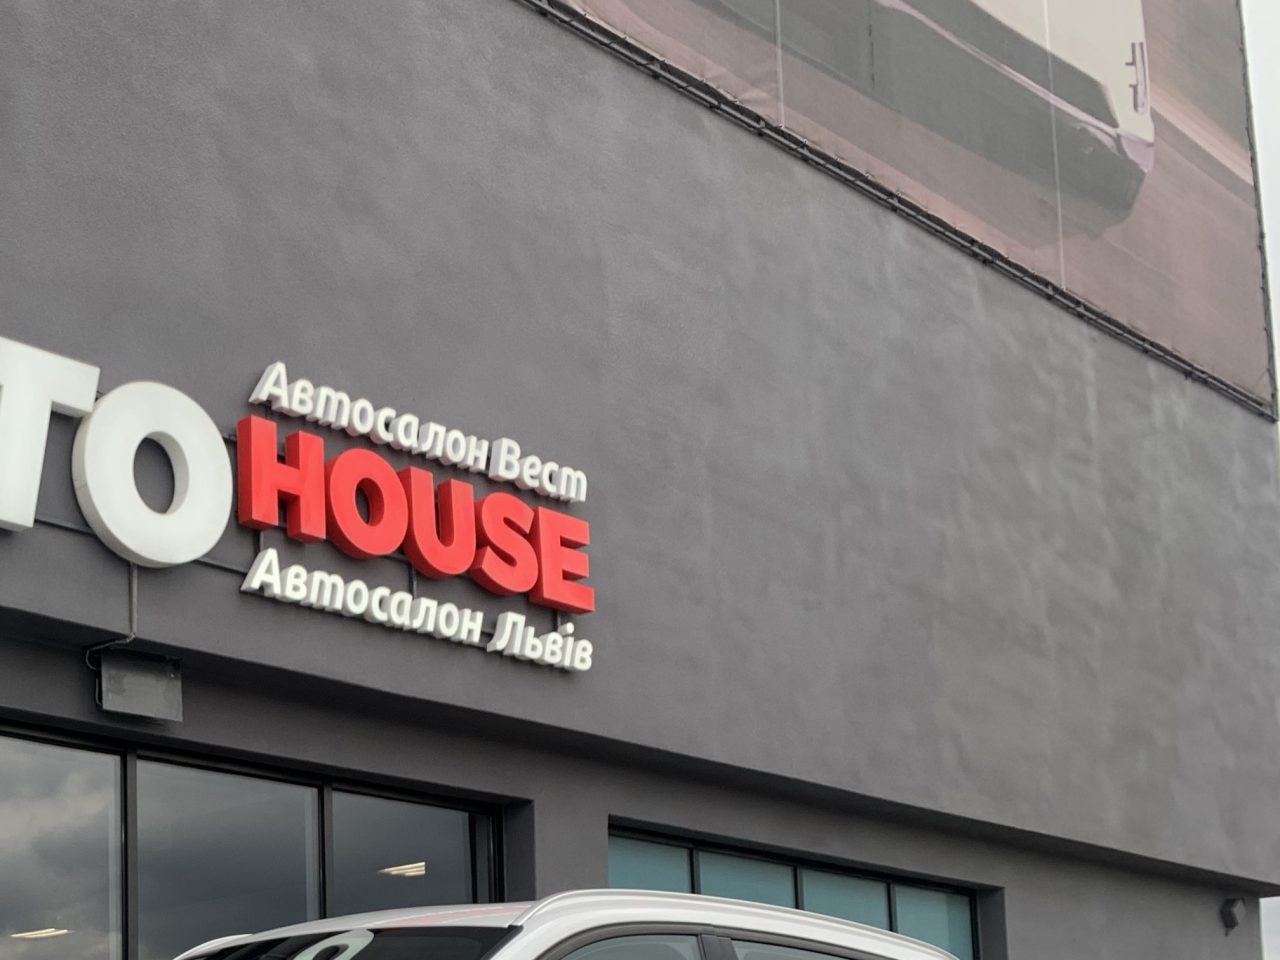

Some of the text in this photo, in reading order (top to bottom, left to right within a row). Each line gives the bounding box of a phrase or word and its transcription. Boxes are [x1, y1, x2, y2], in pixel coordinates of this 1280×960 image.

[249, 361, 587, 502] Автосалон Вест
[237, 415, 596, 615] HOUSE
[241, 547, 593, 671] Автосалон Львів
